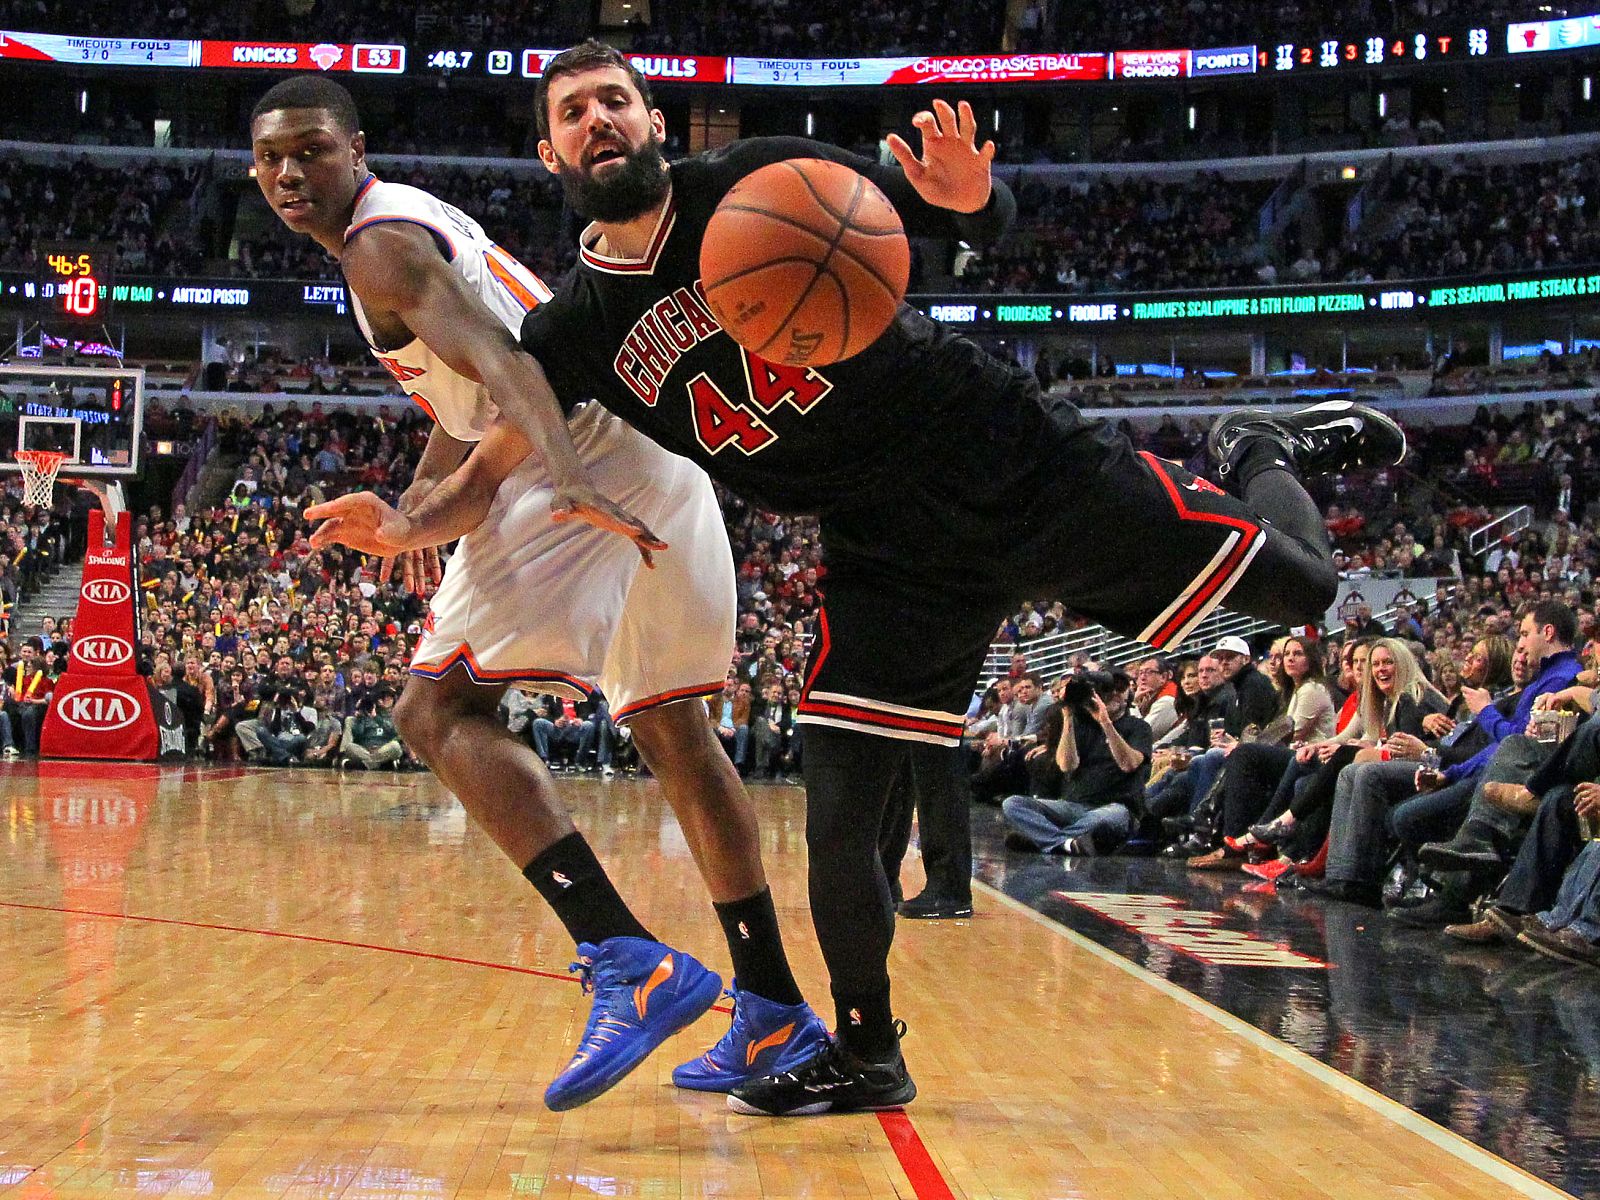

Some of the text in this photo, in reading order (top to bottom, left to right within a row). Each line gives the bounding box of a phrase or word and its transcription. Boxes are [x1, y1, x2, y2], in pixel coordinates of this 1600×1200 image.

[66, 39, 171, 51] TIMEOUTS FOULS
[1275, 44, 1294, 58] 17
[1320, 41, 1339, 54] 17
[1345, 44, 1358, 61] 3
[1391, 40, 1405, 56] 4
[1438, 36, 1452, 53] T
[82, 49, 89, 60] 3
[102, 50, 109, 60] 0
[146, 52, 154, 62] 4
[232, 46, 298, 64] KNICKS
[367, 49, 392, 66] 53
[427, 51, 473, 69] :46.7
[495, 54, 507, 69] 3
[1123, 53, 1181, 64] NEW YORK
[1196, 54, 1250, 70] POINTS
[1258, 51, 1268, 67] 1
[1300, 48, 1312, 64] 2
[630, 57, 697, 77] BULLS
[757, 60, 861, 71] TIMEOUTS FOULS
[913, 56, 1084, 74] CHICAGO BASKETBALL
[1122, 65, 1180, 78] CHICAGO
[773, 71, 780, 81] 3
[794, 71, 800, 81] 1
[839, 71, 845, 81] 1
[65, 278, 97, 314] 10
[130, 286, 153, 302] BAO
[172, 287, 249, 305] ANTICO POSTO
[1428, 288, 1456, 306] JOE'S
[1457, 283, 1505, 304] SEAFOOD,
[1507, 281, 1540, 300] PRIME
[1541, 278, 1576, 297] STEAK
[1577, 277, 1586, 294] &
[930, 305, 977, 321] EVEREST
[997, 306, 1052, 321] FOODEASE
[1069, 304, 1117, 321] FOODLIFE
[1133, 294, 1365, 319] FRANKIE'S SCALOPPINE & 5TH FLOOR PIZZERIA
[685, 345, 834, 457] 44
[87, 555, 126, 567] SPALDING
[89, 584, 122, 599] KIA
[83, 641, 123, 659] KIA
[72, 697, 126, 722] KIA
